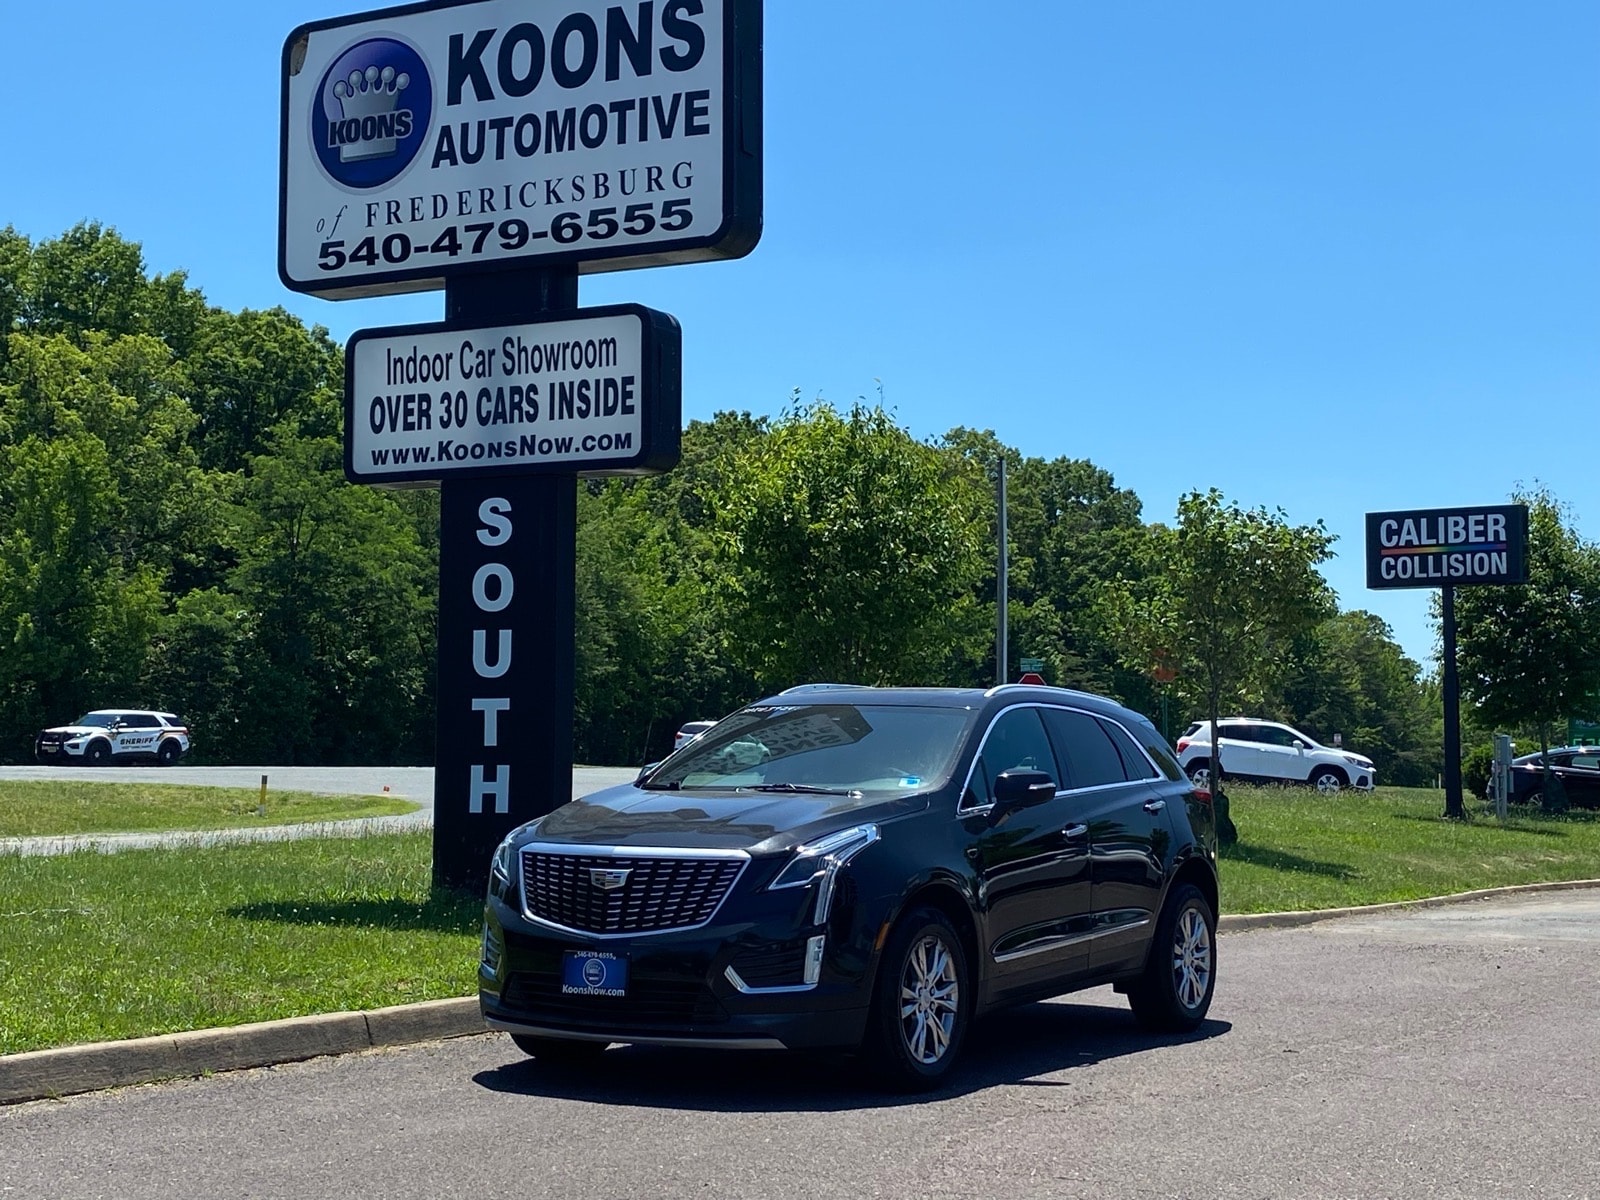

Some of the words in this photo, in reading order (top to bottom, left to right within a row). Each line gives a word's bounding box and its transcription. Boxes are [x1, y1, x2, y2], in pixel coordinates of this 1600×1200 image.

[446, 0, 705, 106] KOONS
[327, 109, 414, 148] KOONS
[431, 89, 711, 169] AUTOMOTIVE
[315, 205, 348, 240] of
[365, 161, 695, 228] FREDERICKSBURG
[317, 198, 694, 272] 540-479-6555
[386, 345, 453, 386] Indoor
[459, 340, 496, 380] Car
[501, 336, 618, 377] Showroom
[369, 392, 432, 435] OVER
[439, 389, 469, 430] 30
[476, 383, 539, 427] CARS
[549, 375, 636, 421] INSIDE
[1380, 513, 1507, 547] CALIBER
[1381, 552, 1508, 580] COLLISION
[469, 497, 514, 814] SOUTH
[120, 737, 154, 745] SHERIFF
[562, 984, 625, 996] KoonsNow.com
